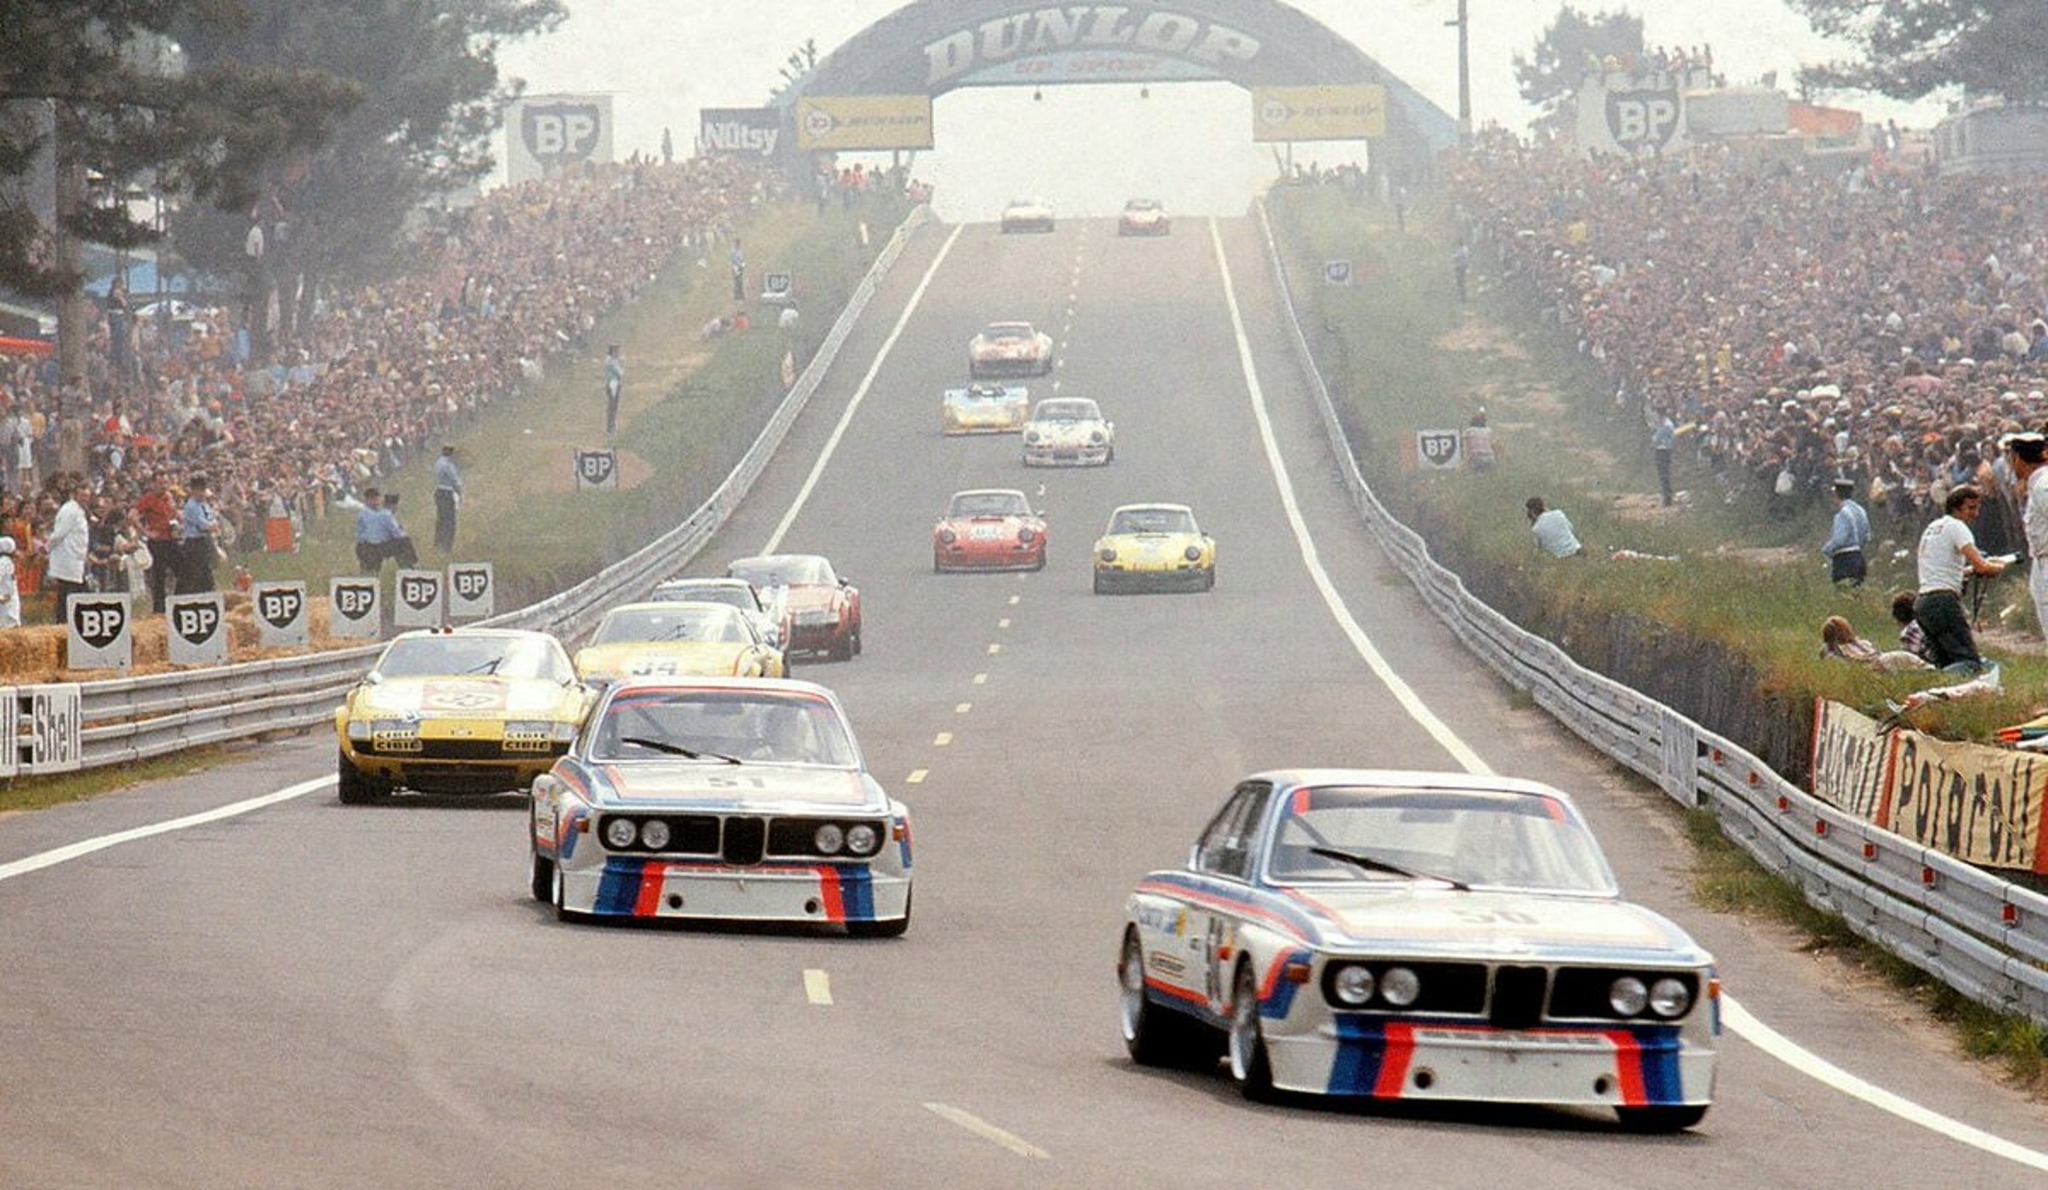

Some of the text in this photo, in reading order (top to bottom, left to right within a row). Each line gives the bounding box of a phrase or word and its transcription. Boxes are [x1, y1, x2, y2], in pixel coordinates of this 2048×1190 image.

[924, 7, 1260, 85] DUNLOP
[1618, 100, 1675, 139] BP
[535, 115, 594, 153] BP
[770, 276, 788, 289] BP
[1425, 438, 1452, 456] BP
[584, 457, 610, 476] BP
[406, 583, 435, 602] BP
[454, 575, 486, 593] BP
[264, 595, 298, 618] BP
[341, 590, 371, 612] BP
[81, 610, 121, 637] BP
[179, 609, 216, 634] BP
[35, 694, 78, 763] Shell
